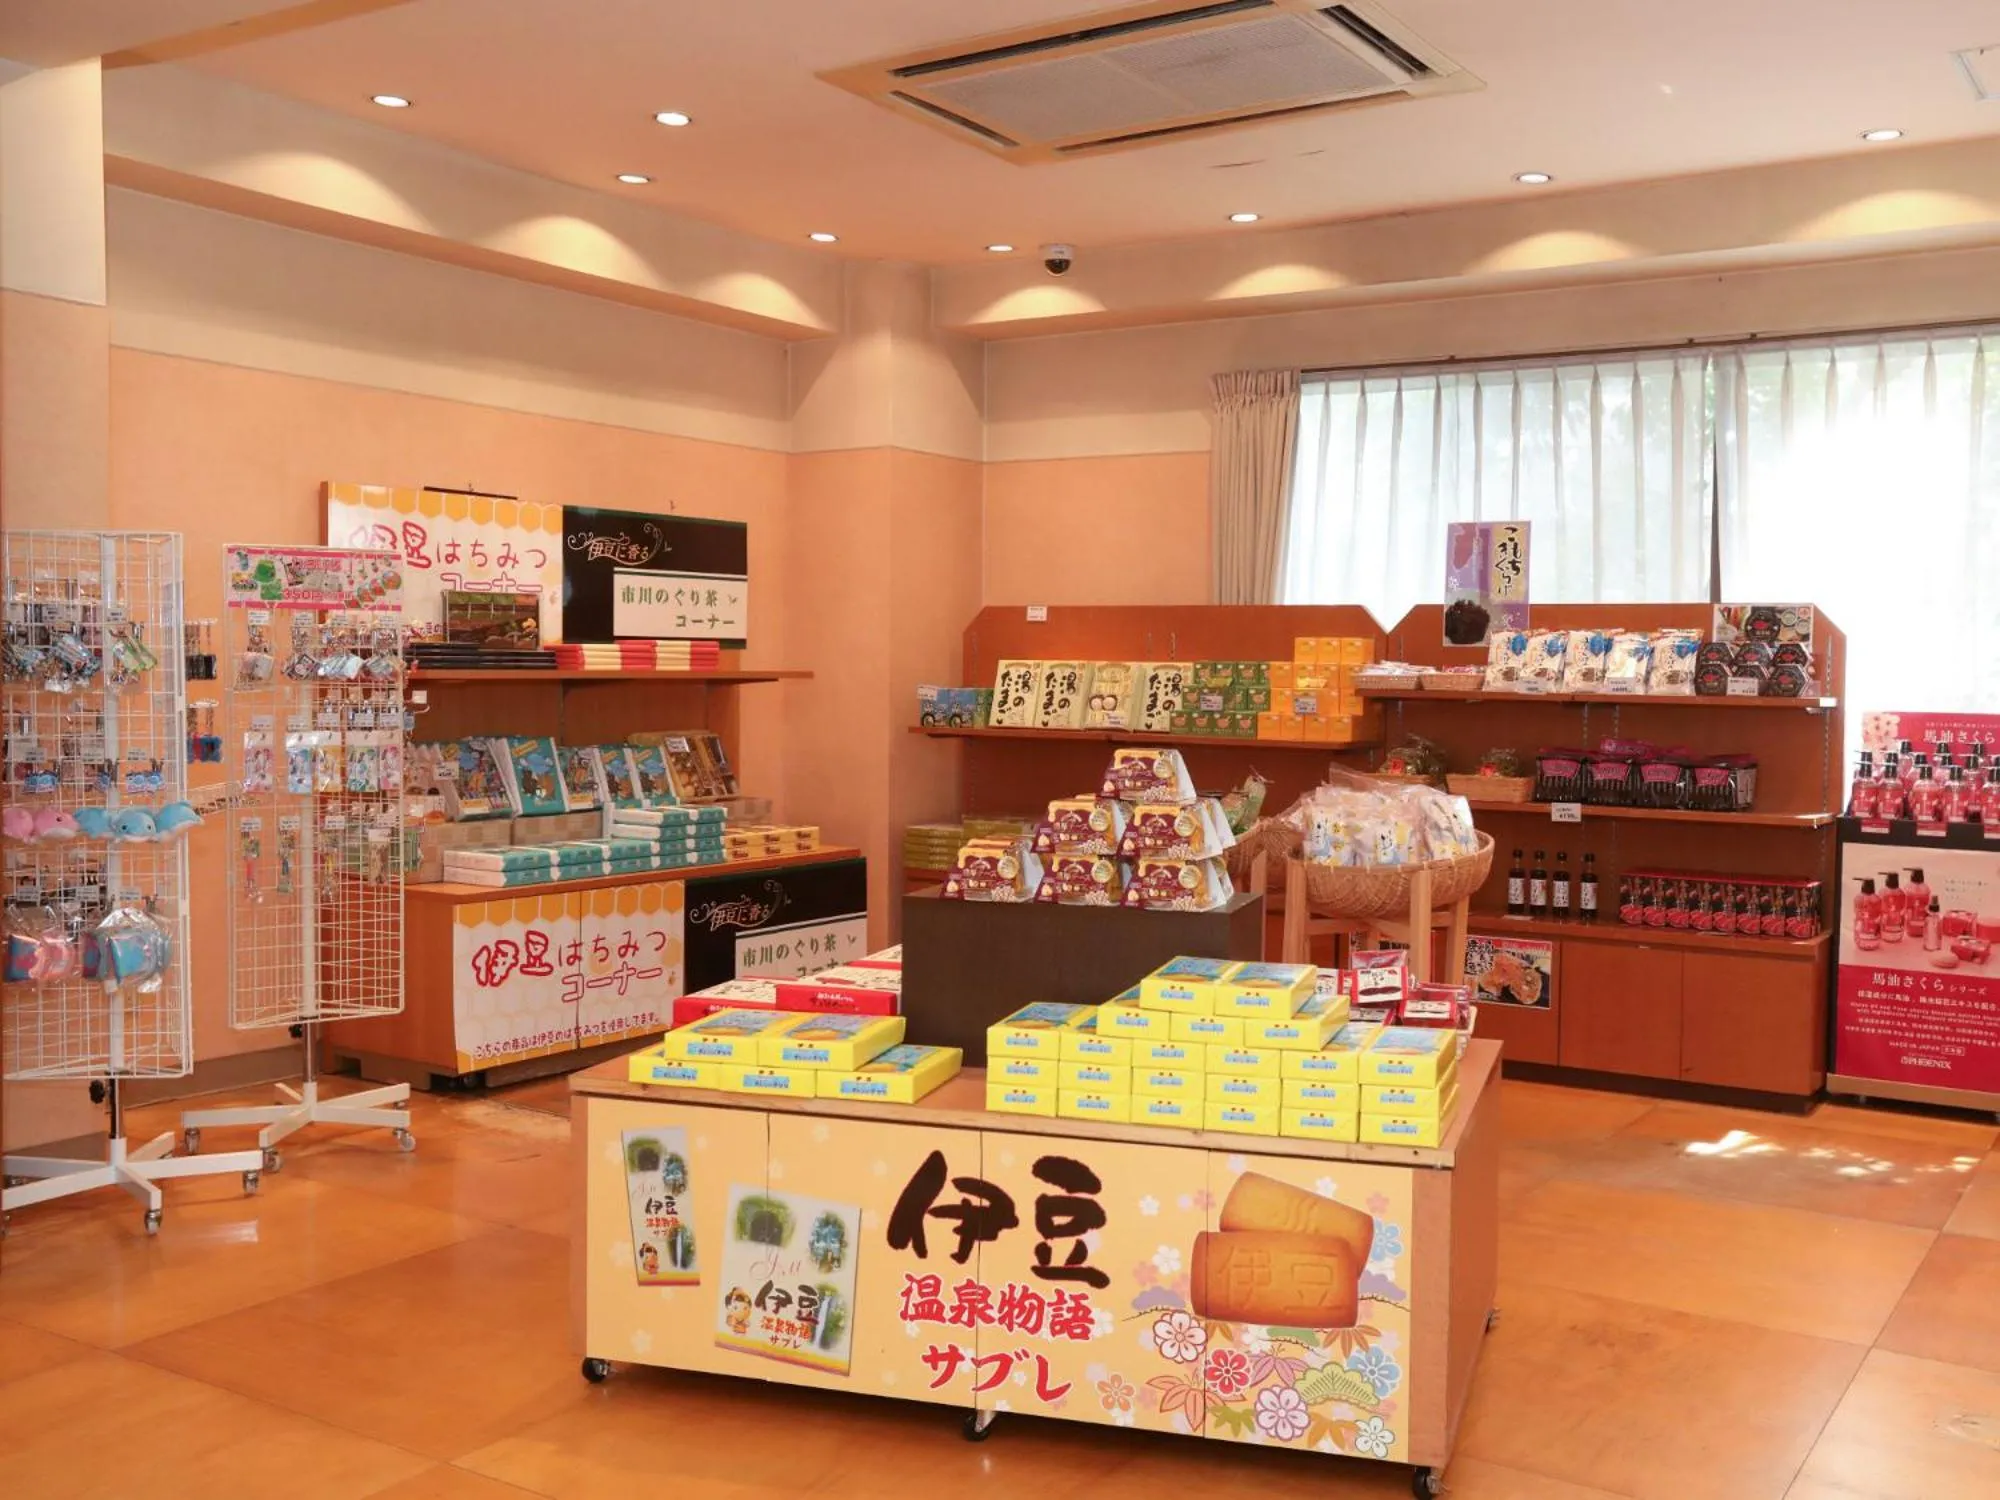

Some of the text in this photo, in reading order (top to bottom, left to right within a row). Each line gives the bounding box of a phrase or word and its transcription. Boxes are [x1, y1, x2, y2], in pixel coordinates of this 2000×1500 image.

[622, 585, 718, 606] 市川のぐり茶
[675, 613, 735, 629] コーナー
[472, 930, 667, 988] 伊豆はちみつ
[743, 934, 837, 967] 市川のぐり茶
[562, 961, 663, 1003] コーナー
[1872, 972, 1988, 995] 馬油さくら シリーズ
[645, 1195, 678, 1215] 伊豆
[886, 1150, 1110, 1289] 伊豆
[754, 1280, 820, 1325] 伊豆
[900, 1274, 1095, 1340] 温泉物語
[761, 1315, 813, 1340] 温泉物語
[769, 1335, 801, 1350] サブレ
[921, 1344, 1071, 1402] サブレ
